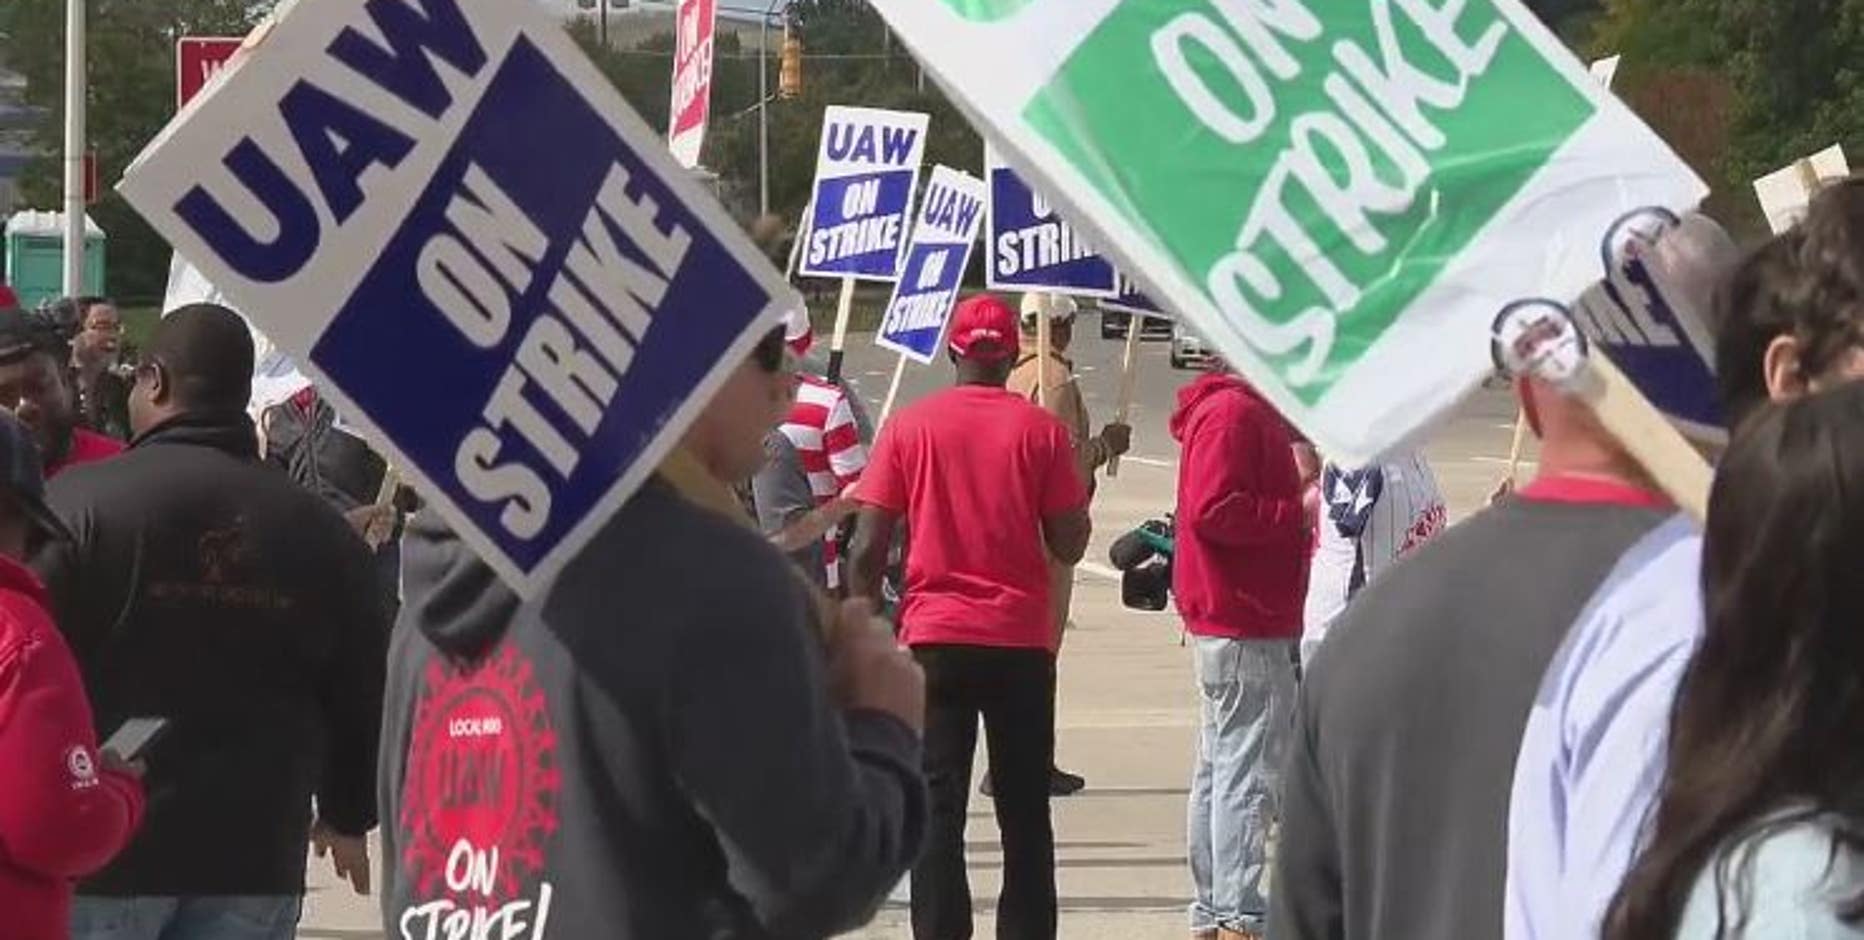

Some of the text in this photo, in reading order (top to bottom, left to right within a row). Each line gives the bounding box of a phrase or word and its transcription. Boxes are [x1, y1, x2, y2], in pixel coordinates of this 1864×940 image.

[1150, 0, 1323, 144] ON
[172, 0, 489, 284] UAW
[827, 123, 918, 166] UAW
[842, 179, 881, 219] ON
[924, 184, 983, 238] UAW
[1207, 0, 1508, 387] STRIKE
[416, 160, 550, 350] ON
[809, 213, 902, 267] STRIKE
[917, 249, 950, 291] ON
[887, 290, 951, 335] STRIKE
[454, 160, 693, 541] STRIKE
[438, 748, 504, 808] UAW
[446, 838, 498, 896] ON
